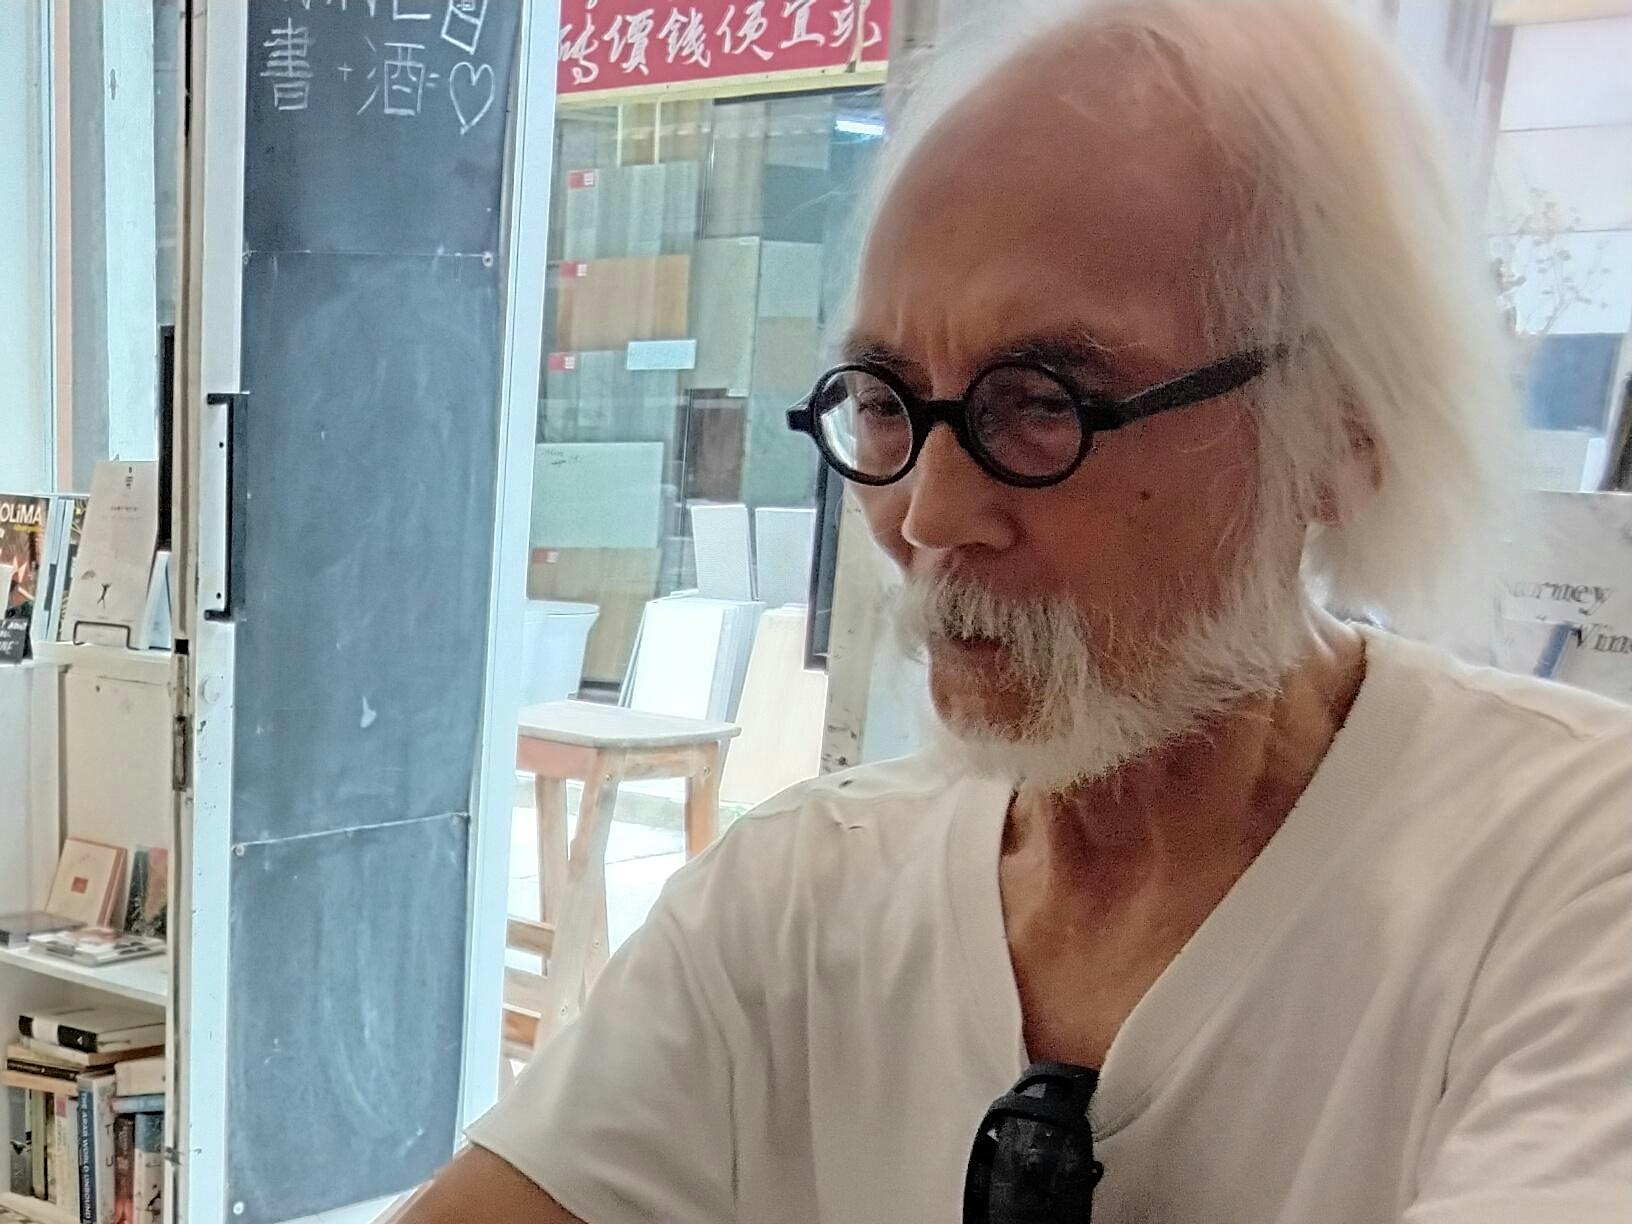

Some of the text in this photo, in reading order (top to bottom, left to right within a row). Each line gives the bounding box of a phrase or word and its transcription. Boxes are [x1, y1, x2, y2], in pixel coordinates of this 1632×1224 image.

[260, 17, 315, 111] 書
[357, 35, 426, 116] 酒
[81, 1112, 89, 1137] ARAB
[82, 1138, 90, 1173] WORLD
[83, 1174, 91, 1219] UNBOUND
